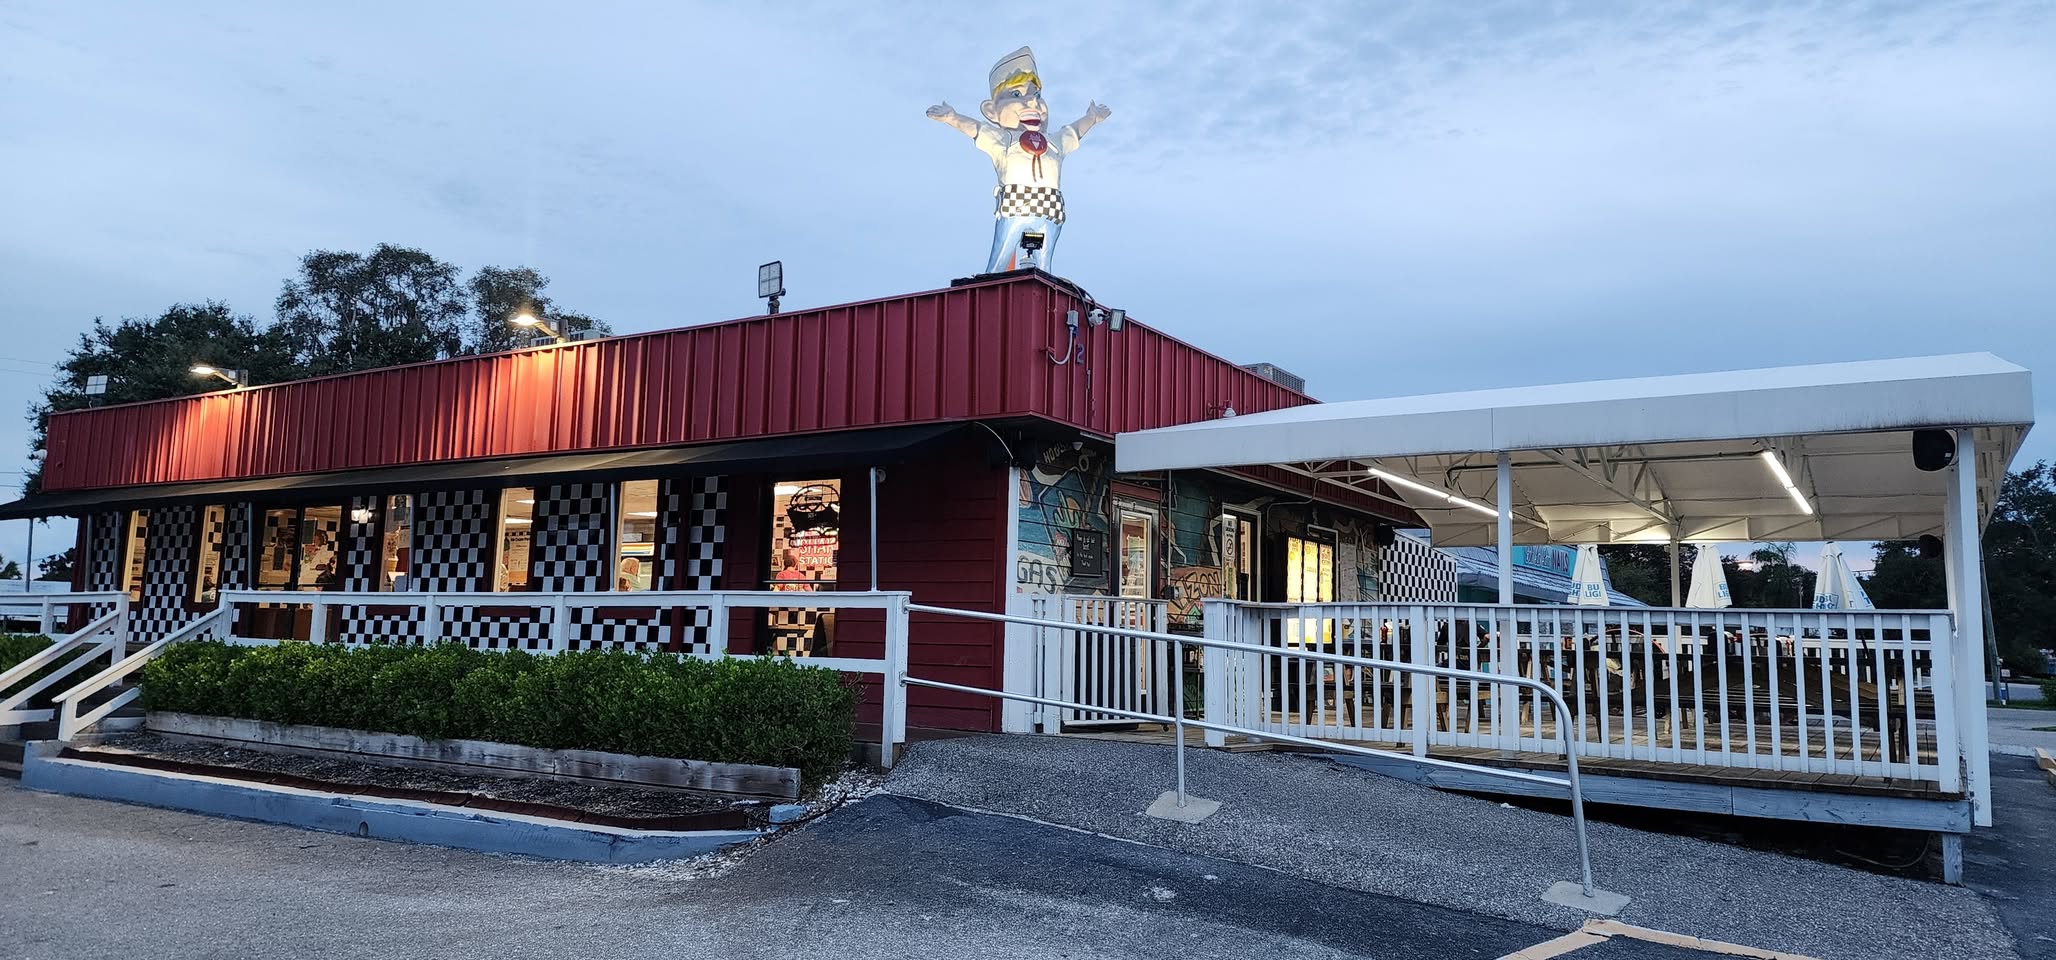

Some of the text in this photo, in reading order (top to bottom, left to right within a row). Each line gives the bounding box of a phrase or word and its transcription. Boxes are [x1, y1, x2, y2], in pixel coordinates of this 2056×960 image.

[1552, 549, 1569, 573] NAILS
[1017, 555, 1058, 595] GAS
[1584, 590, 1602, 598] LIG
